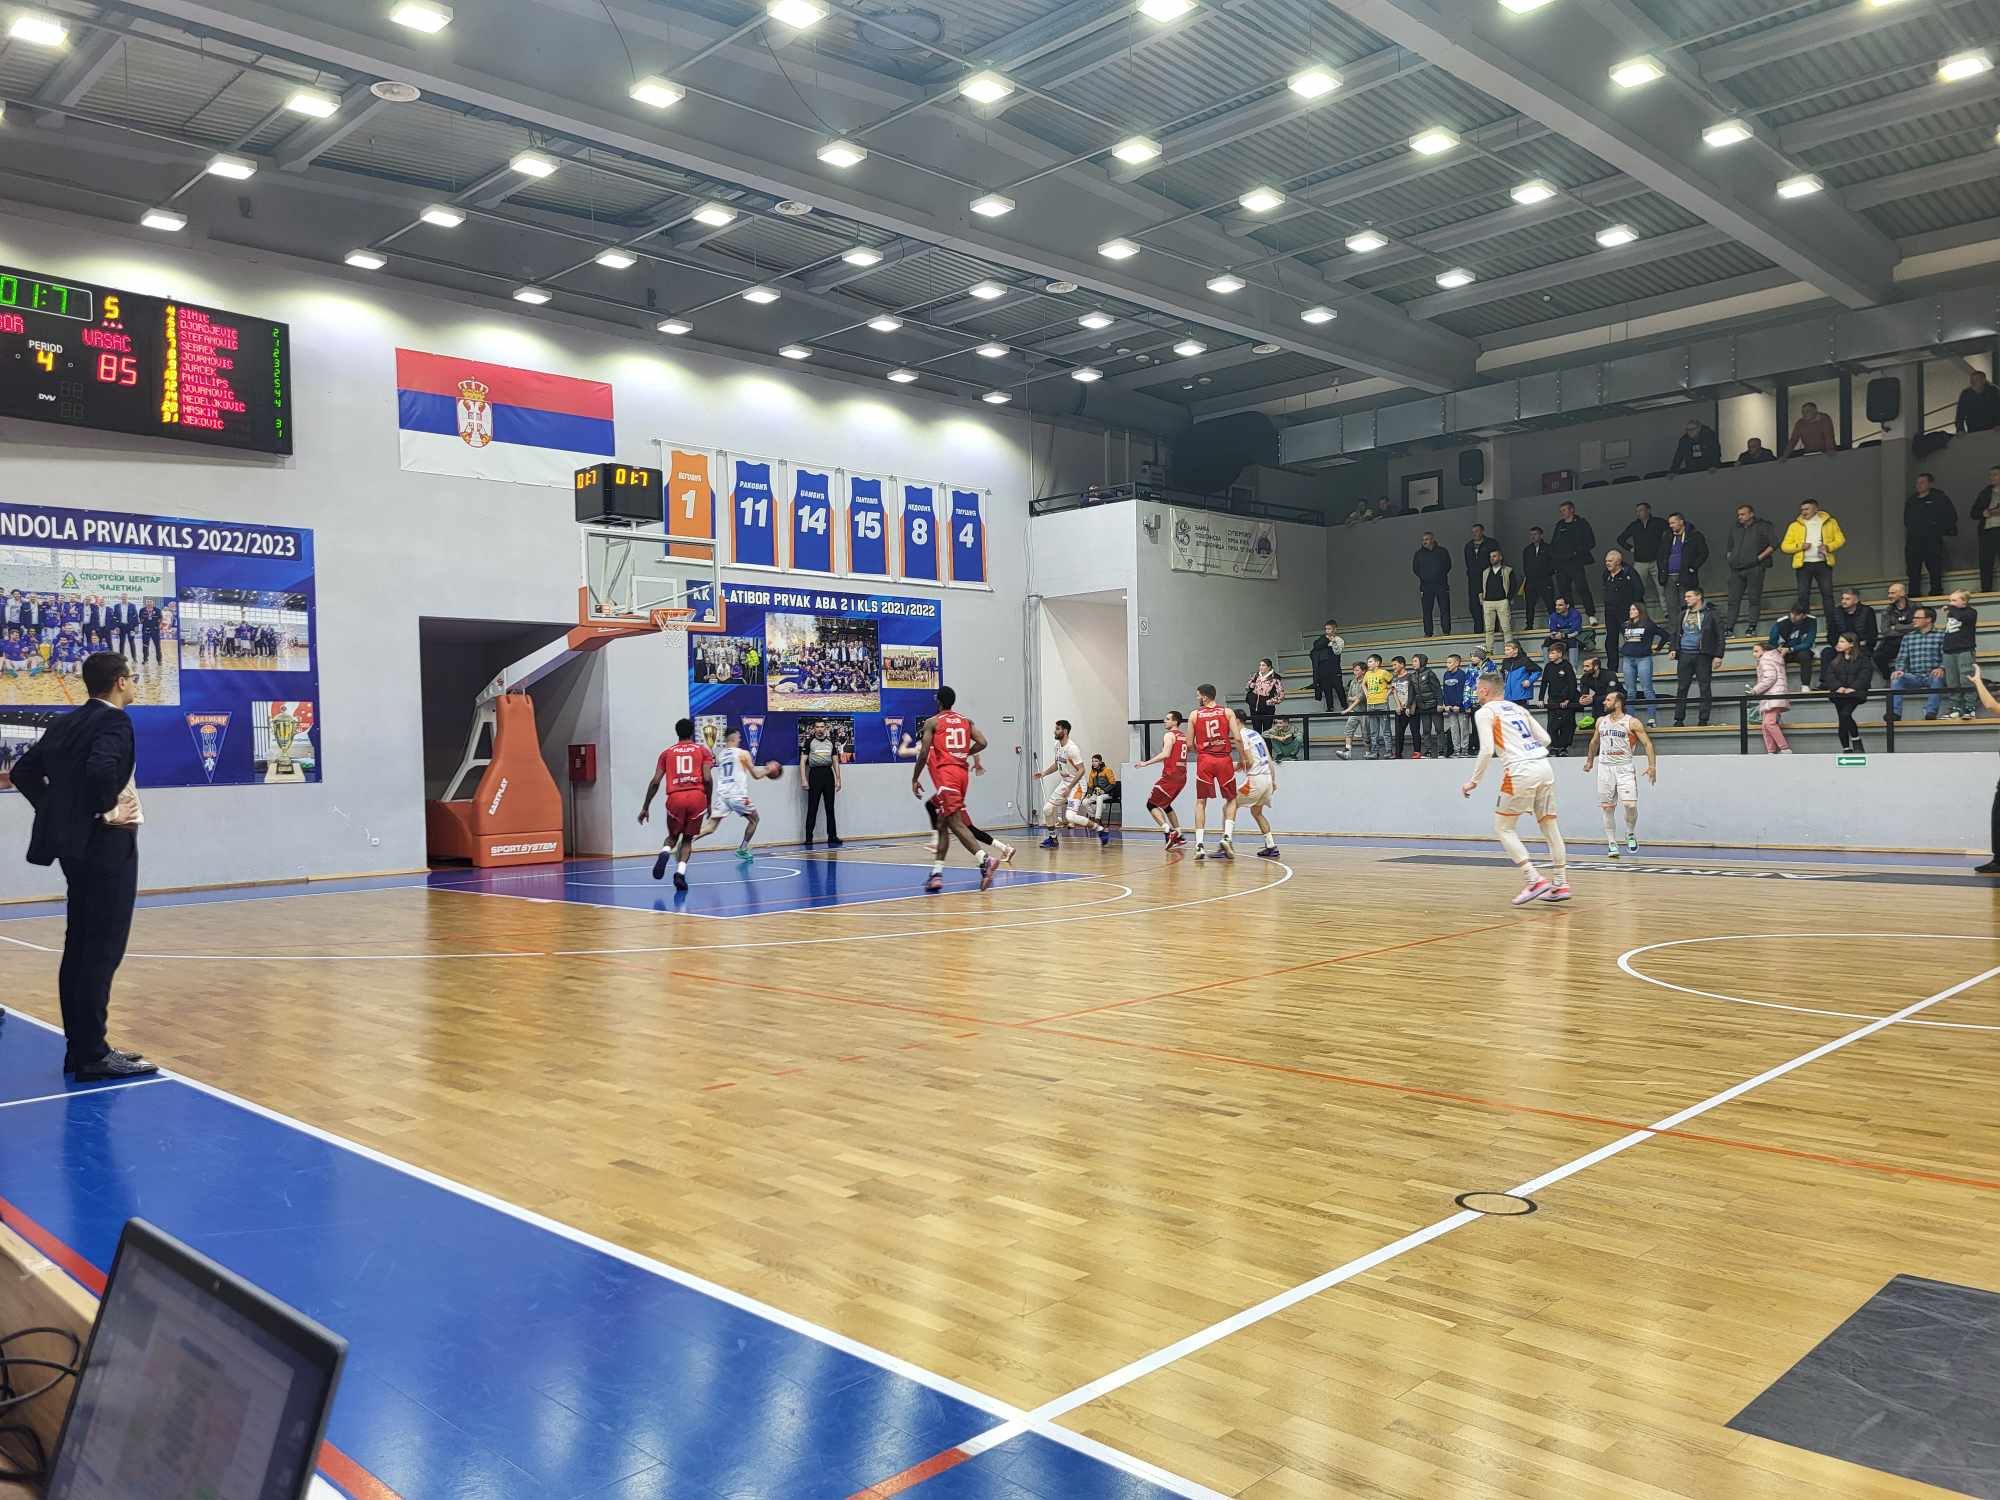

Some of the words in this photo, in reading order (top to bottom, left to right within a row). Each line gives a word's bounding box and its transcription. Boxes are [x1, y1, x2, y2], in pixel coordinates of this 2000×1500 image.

[28, 340, 63, 353] PERIOD
[37, 350, 54, 371] 4
[98, 353, 137, 385] 85
[182, 372, 229, 389] PHILLIPS
[682, 489, 696, 519] 1
[740, 497, 768, 527] 11
[798, 505, 827, 535] 14
[854, 511, 881, 539] 15
[911, 518, 928, 545] 8
[83, 519, 153, 546] PRVAK
[157, 525, 193, 549] KLS
[197, 529, 295, 556] 2022/2023
[958, 523, 974, 548] 4
[773, 593, 810, 608] PRVAK
[815, 597, 838, 610] ABA
[841, 598, 849, 611] 2
[857, 600, 878, 613] KLS
[881, 604, 935, 617] 2021/2022
[946, 728, 966, 748] 20
[1205, 720, 1220, 738] 12
[676, 755, 693, 774] 10
